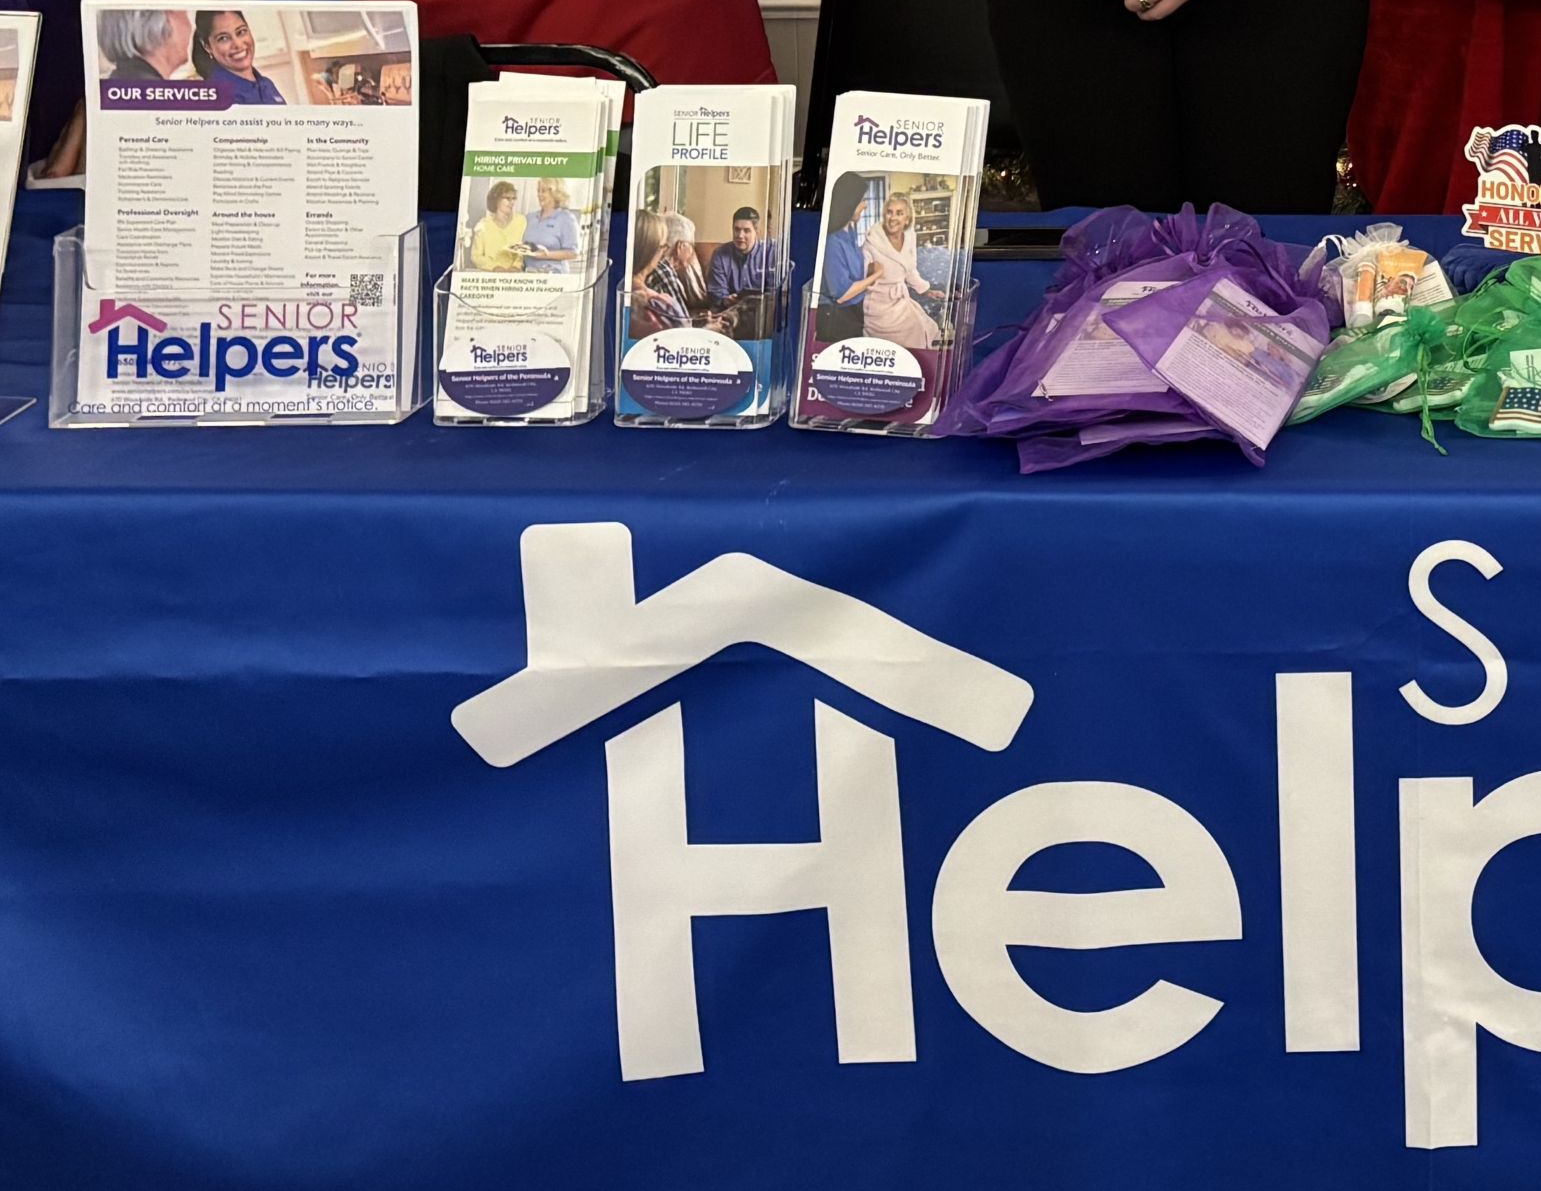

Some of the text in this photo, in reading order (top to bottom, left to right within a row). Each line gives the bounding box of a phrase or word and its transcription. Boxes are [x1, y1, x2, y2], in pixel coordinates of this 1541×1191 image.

[108, 87, 218, 101] OUR SERVICES
[155, 117, 364, 130] Senior Helpers can assist you in so many ways...
[504, 121, 560, 137] Helpers
[896, 119, 944, 131] SENIOR
[672, 121, 730, 147] LIFE
[857, 125, 942, 151] Helpers
[474, 155, 569, 165] HIRING PRIVATE DUTY
[671, 147, 729, 160] PROFILE
[1495, 208, 1529, 226] ALL
[216, 303, 358, 330] SENIOR
[497, 344, 528, 352] SENIOR
[681, 347, 711, 355] SENIOR
[865, 348, 897, 357] SENIOR
[106, 322, 359, 392] Helpers
[474, 350, 528, 366] Helpers
[656, 351, 711, 367] Helpers
[841, 351, 896, 368] Helpers
[68, 398, 379, 415] Care and comfort at a moment's notice.
